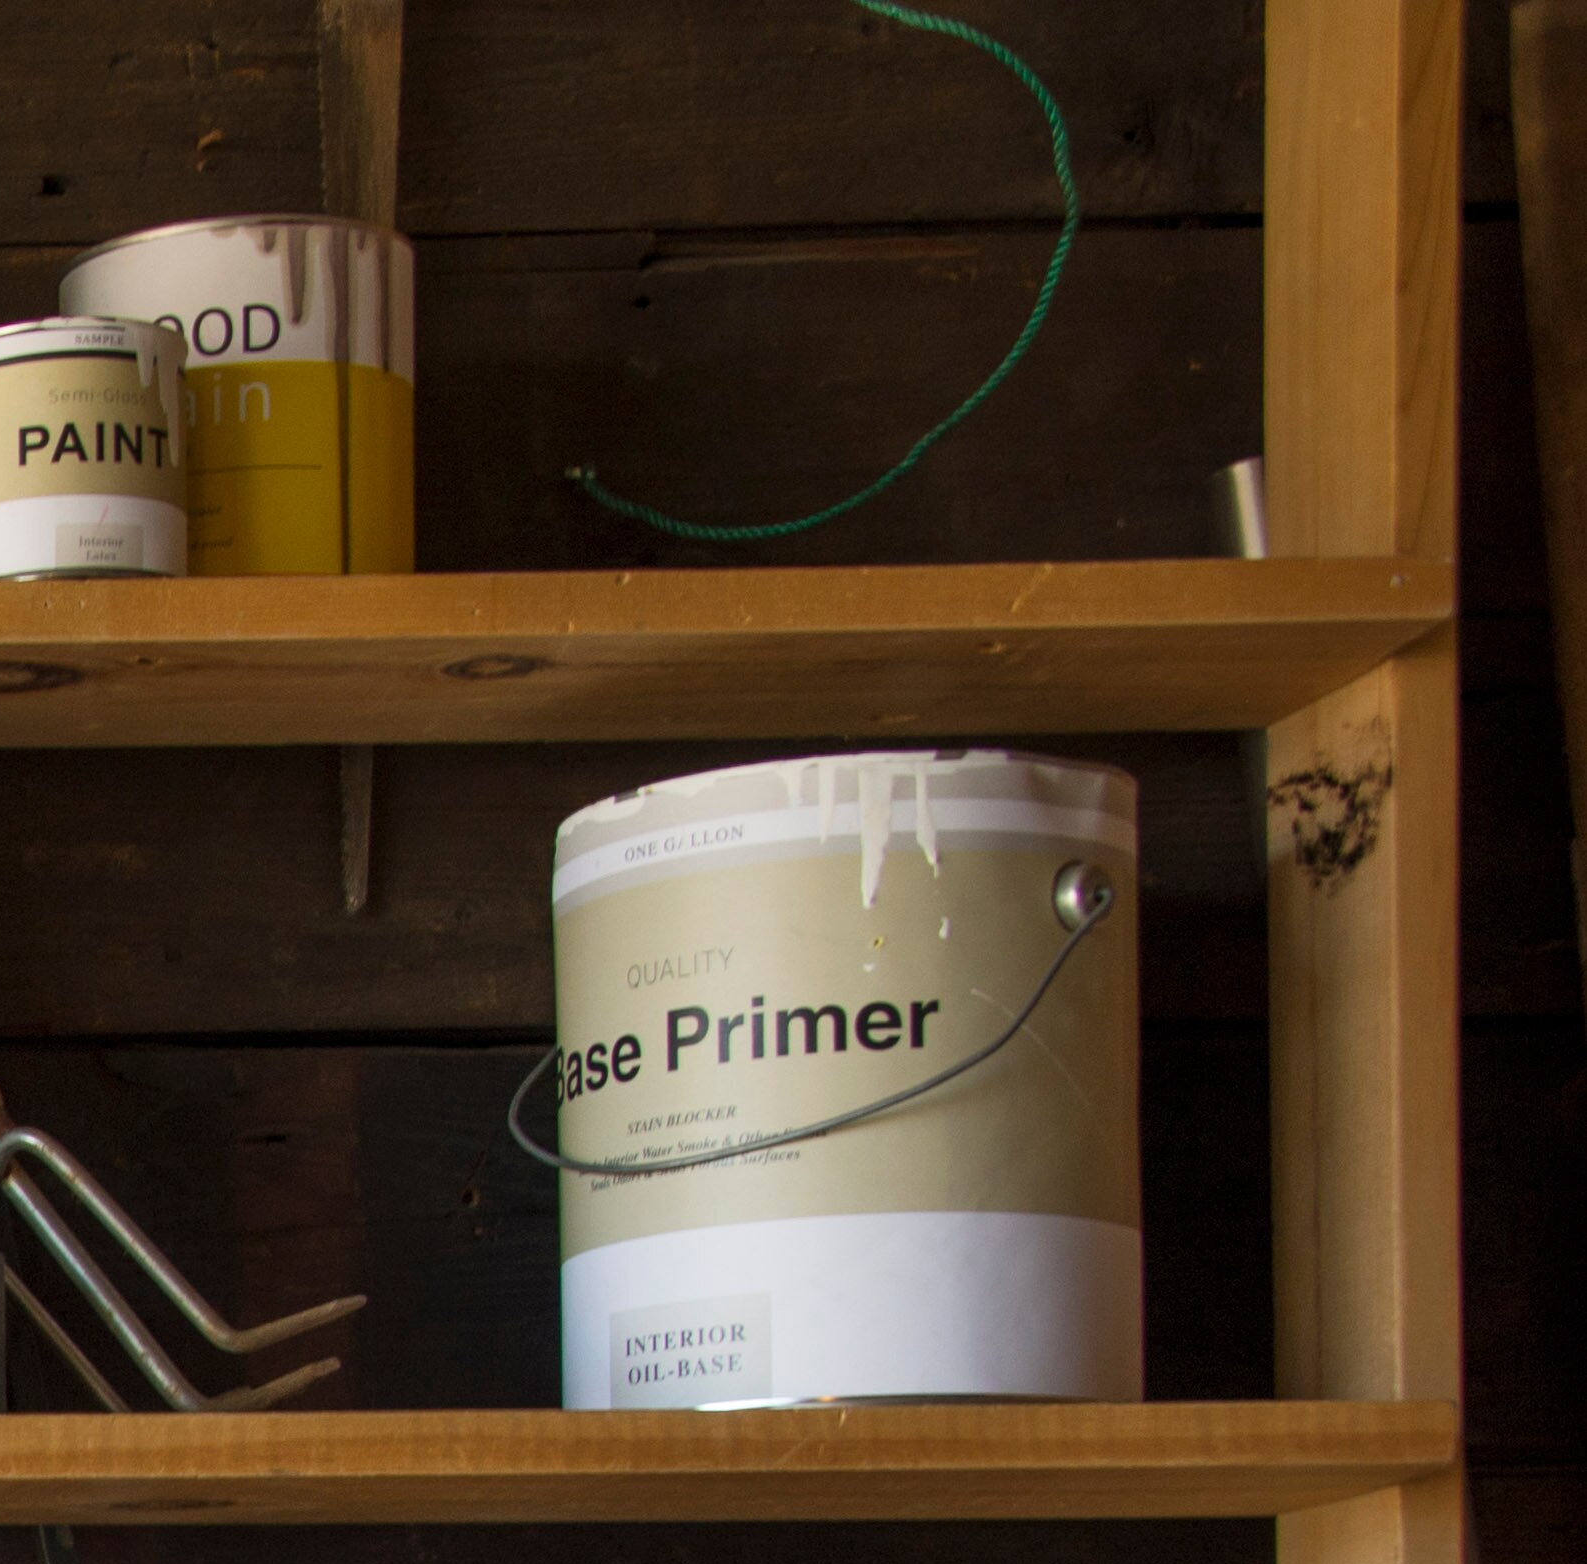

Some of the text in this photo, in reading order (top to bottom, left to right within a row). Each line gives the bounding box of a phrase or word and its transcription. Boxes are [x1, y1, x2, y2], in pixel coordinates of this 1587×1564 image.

[75, 333, 124, 345] SAMPLE
[18, 421, 168, 469] PAINT
[625, 839, 658, 863] ONE
[627, 946, 736, 989] QUALITY
[667, 996, 939, 1073] Primer
[628, 1105, 737, 1136] STAIN BLOCKER
[643, 1144, 673, 1159] Water
[677, 1138, 717, 1153] Smoke
[626, 1323, 746, 1357] INTERIOR
[628, 1353, 742, 1385] OIL-BASE
